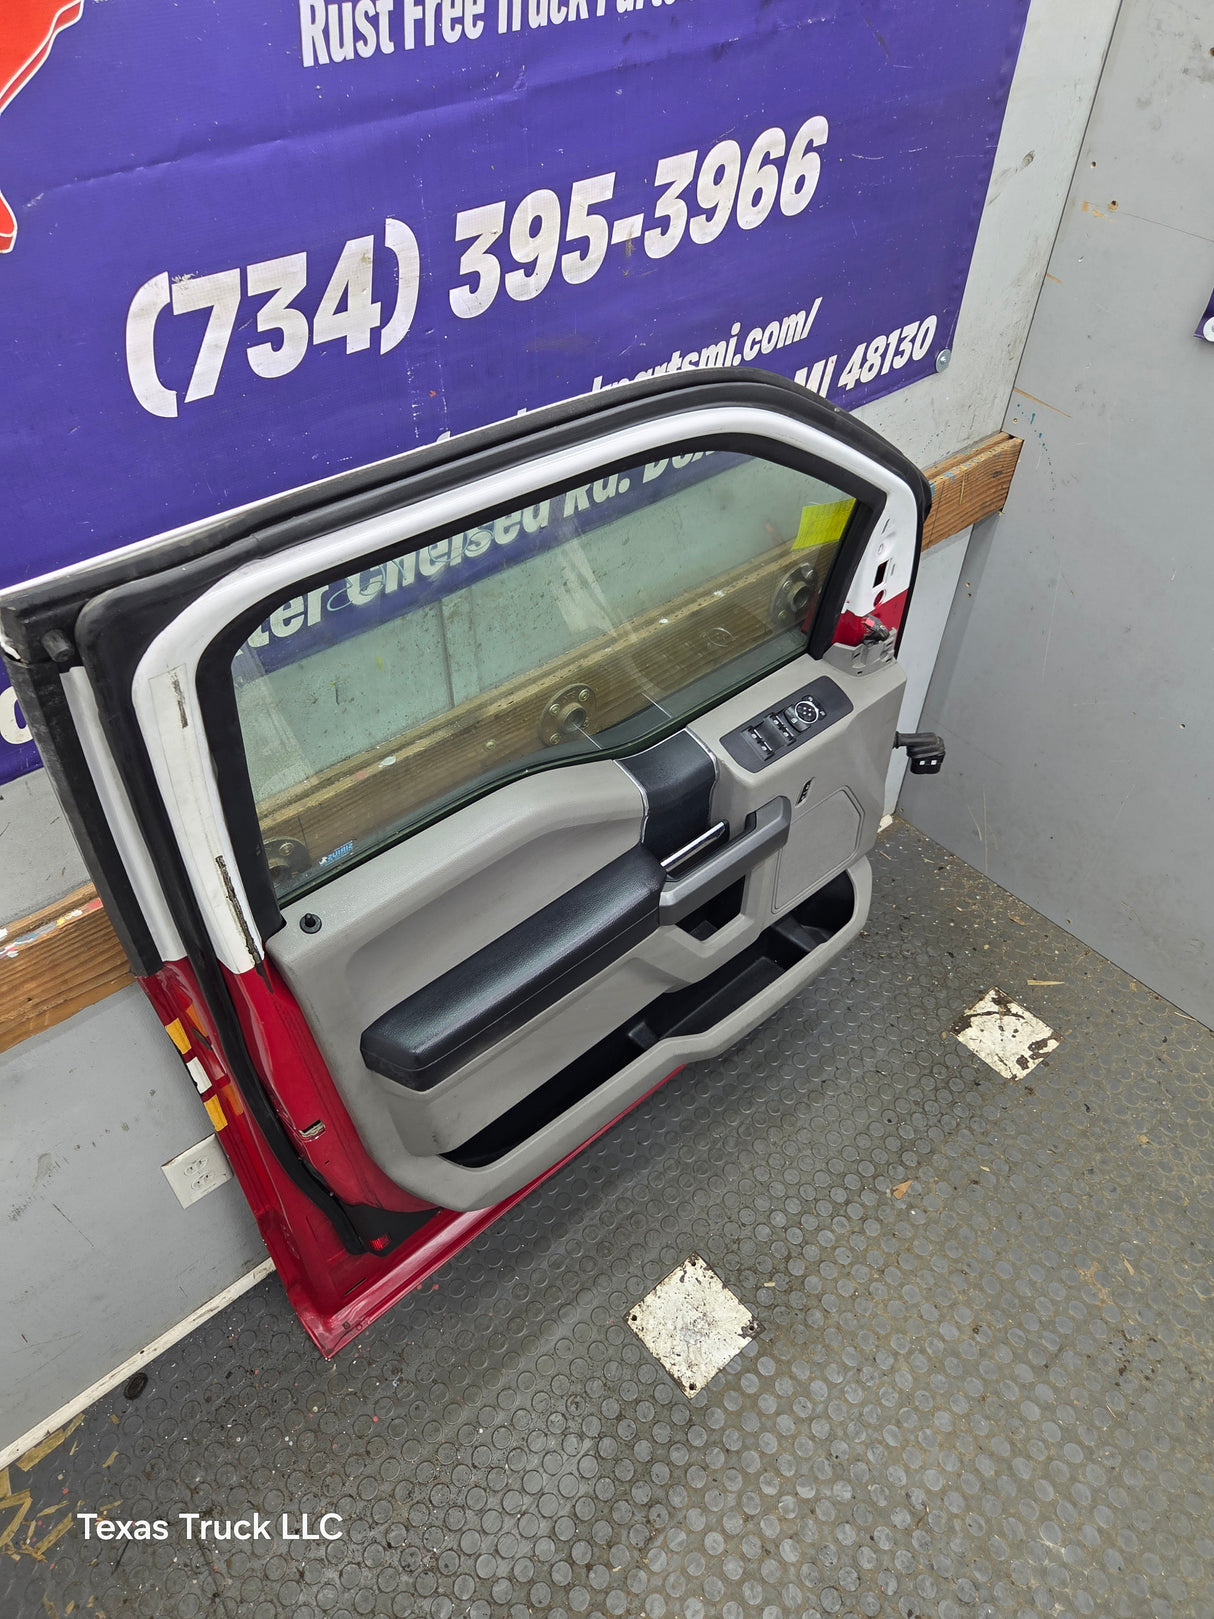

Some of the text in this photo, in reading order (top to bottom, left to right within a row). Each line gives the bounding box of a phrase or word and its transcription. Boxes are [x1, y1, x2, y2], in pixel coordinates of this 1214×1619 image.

[299, 0, 395, 68] Rust
[403, 0, 485, 51] Free
[125, 115, 829, 418] (734) 395-3966
[837, 314, 938, 391] 48130
